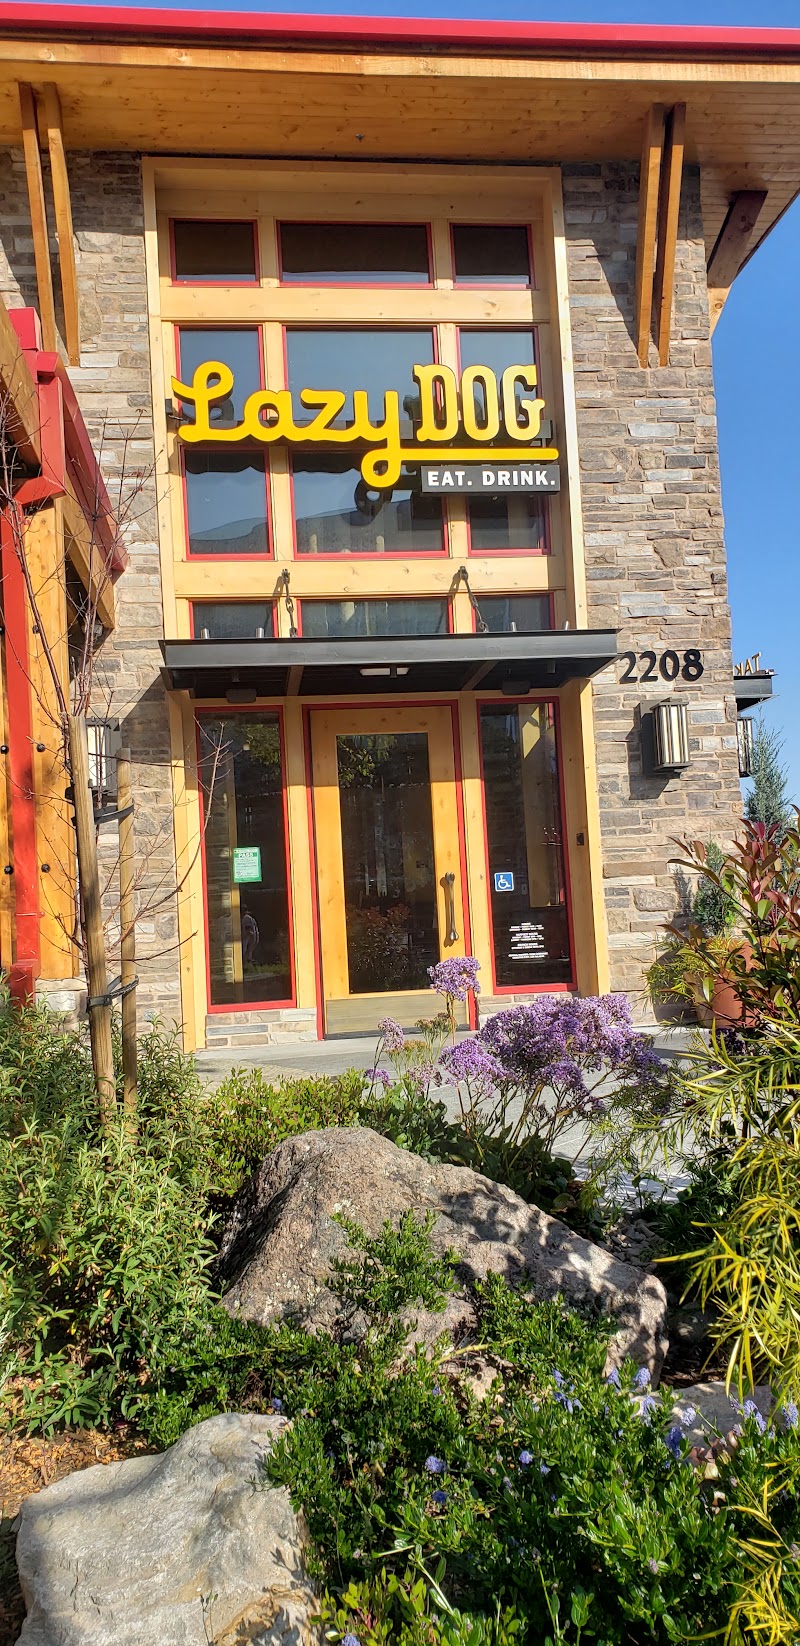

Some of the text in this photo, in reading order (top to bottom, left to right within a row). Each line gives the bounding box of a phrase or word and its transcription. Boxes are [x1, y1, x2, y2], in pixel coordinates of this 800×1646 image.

[171, 360, 546, 488] Lazy DOG
[427, 470, 556, 487] EAT. DRINK.
[618, 649, 705, 684] 2208
